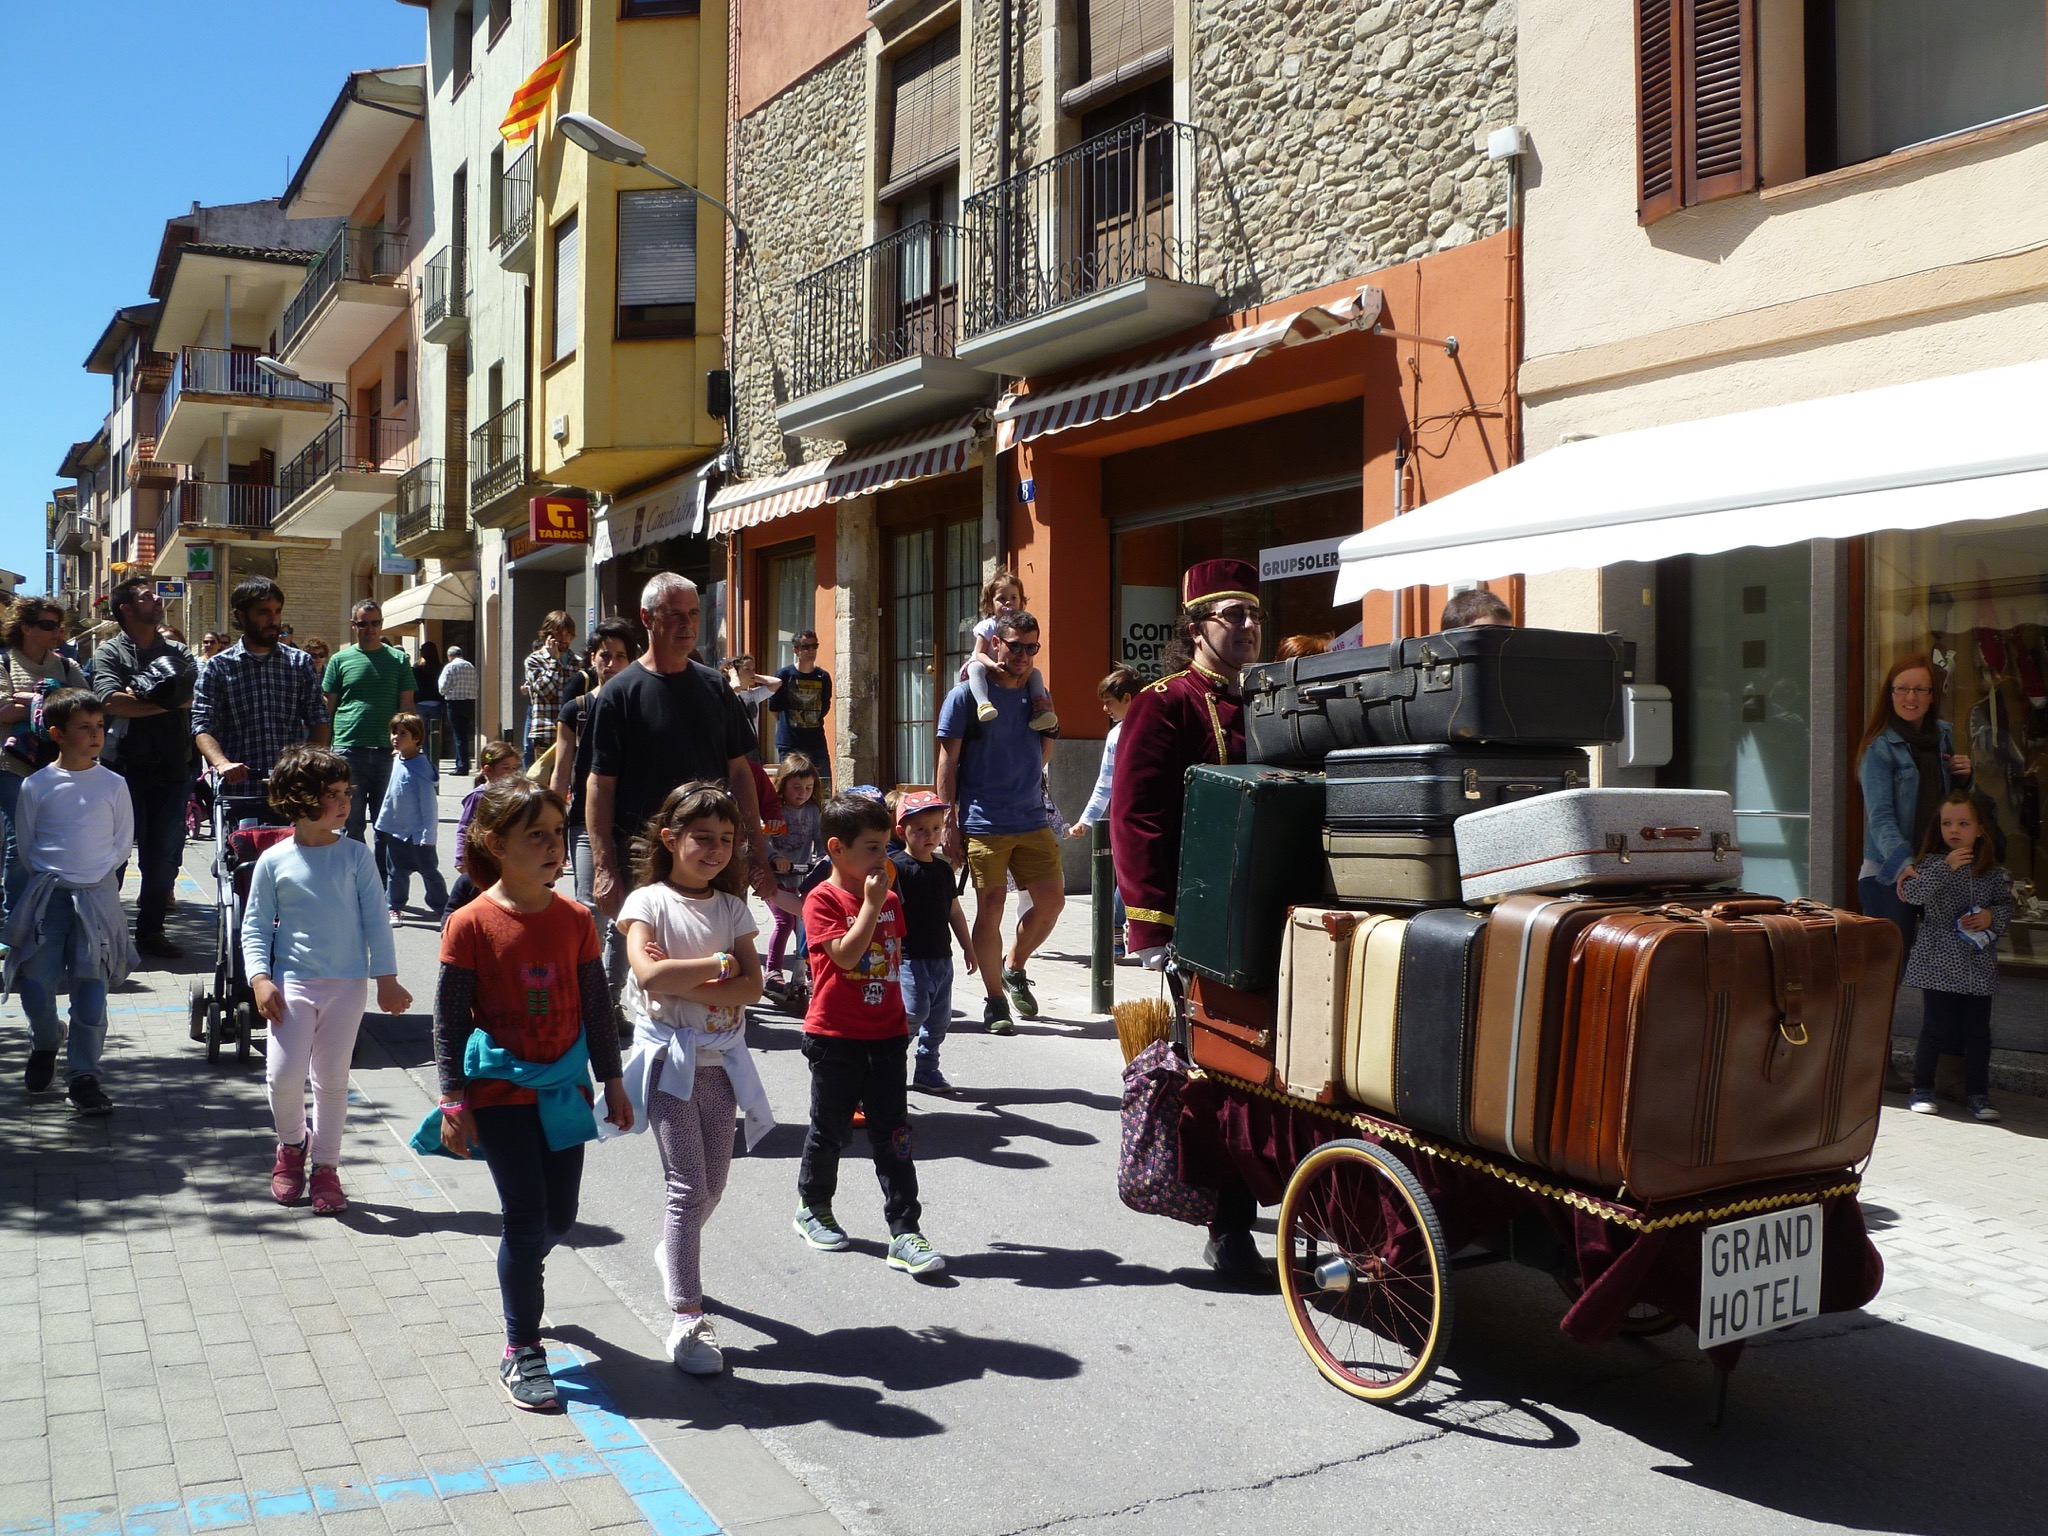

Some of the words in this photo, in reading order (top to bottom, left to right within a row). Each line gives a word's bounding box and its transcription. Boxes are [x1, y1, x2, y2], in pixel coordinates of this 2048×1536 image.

[1021, 483, 1029, 501] 8
[538, 529, 585, 540] TABACS
[1262, 551, 1339, 577] GRUPSOLER
[1711, 1214, 1813, 1277] GRAND
[1708, 1275, 1808, 1339] HOTEL
